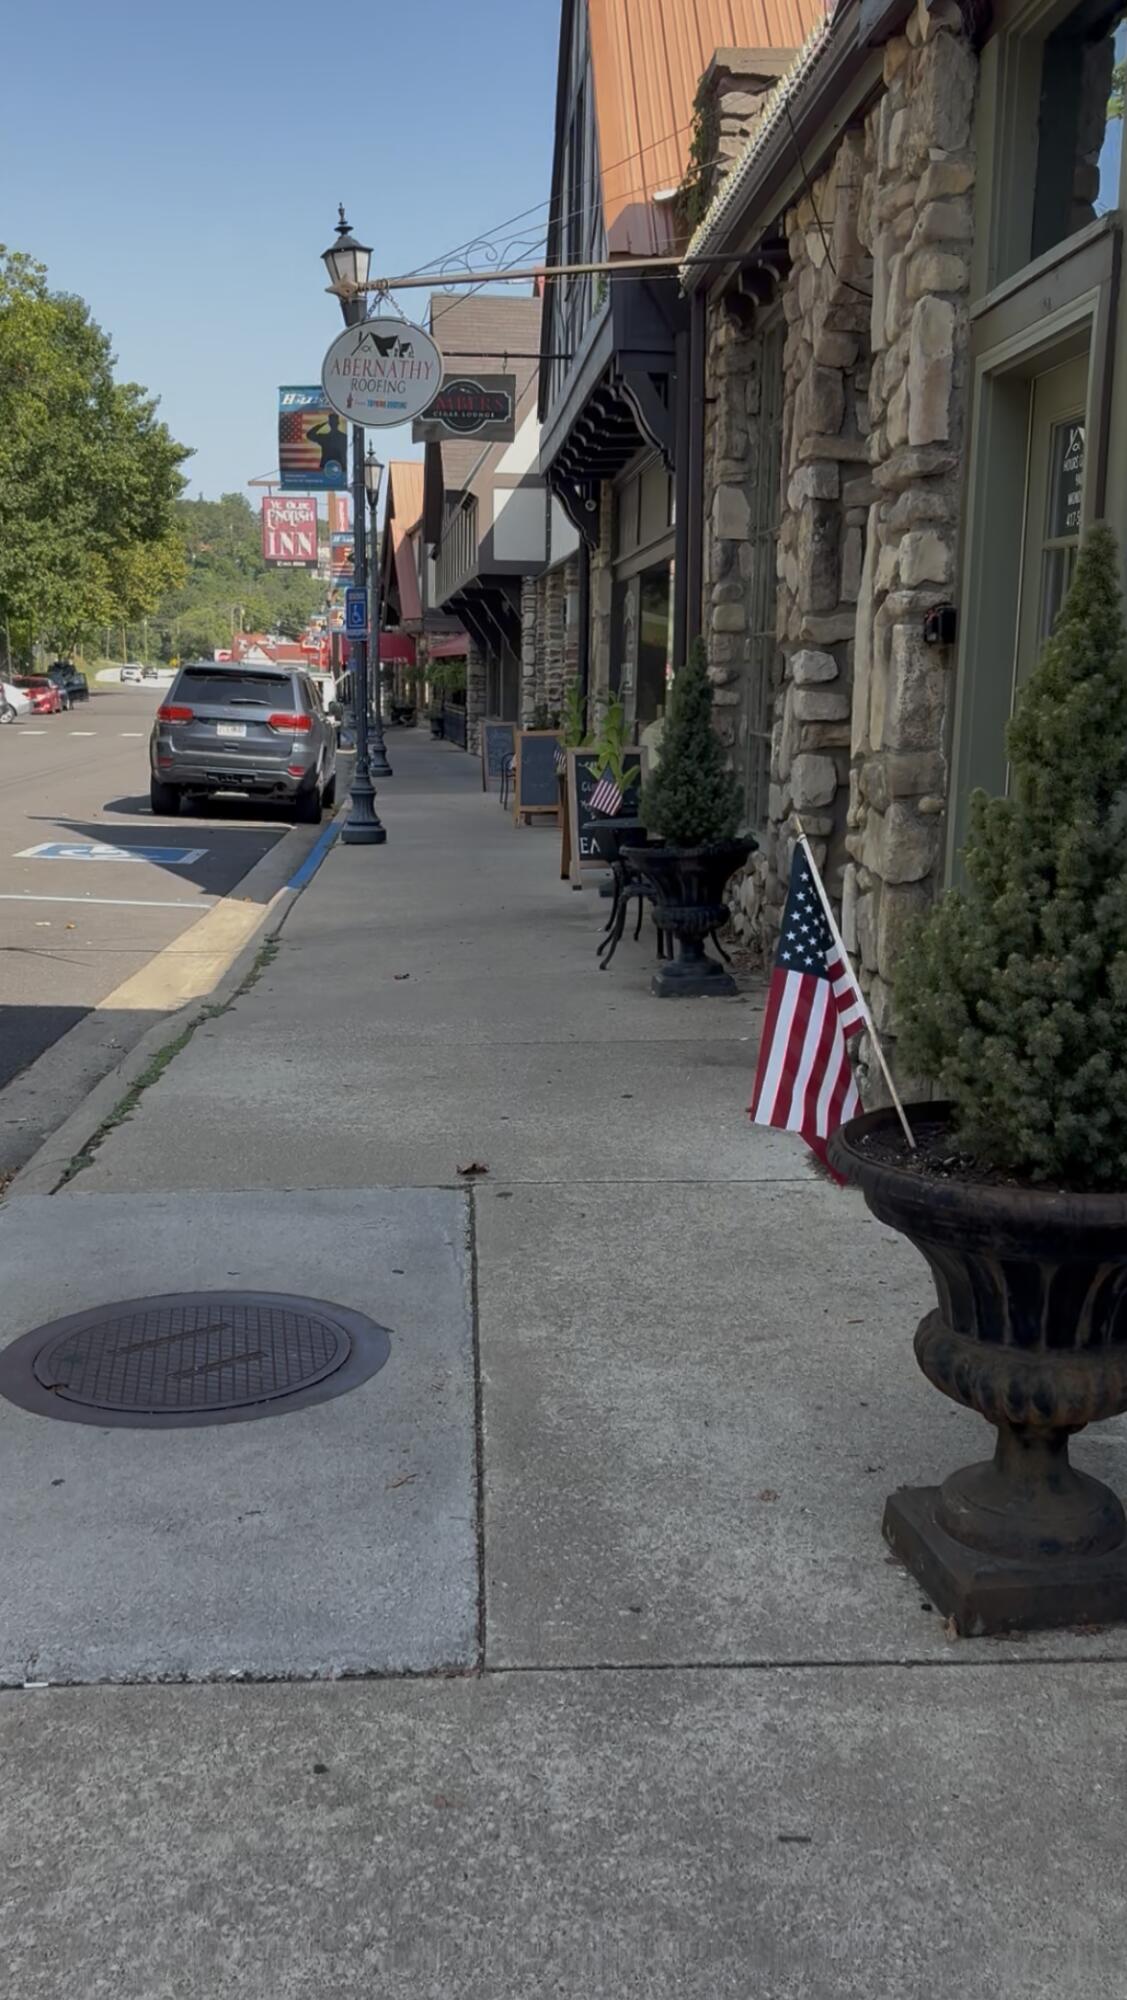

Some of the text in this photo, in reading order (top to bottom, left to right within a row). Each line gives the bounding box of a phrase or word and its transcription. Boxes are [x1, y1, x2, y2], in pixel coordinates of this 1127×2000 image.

[331, 358, 432, 380] ABERNATHY
[351, 378, 406, 394] ROOFING
[269, 531, 313, 556] INN
